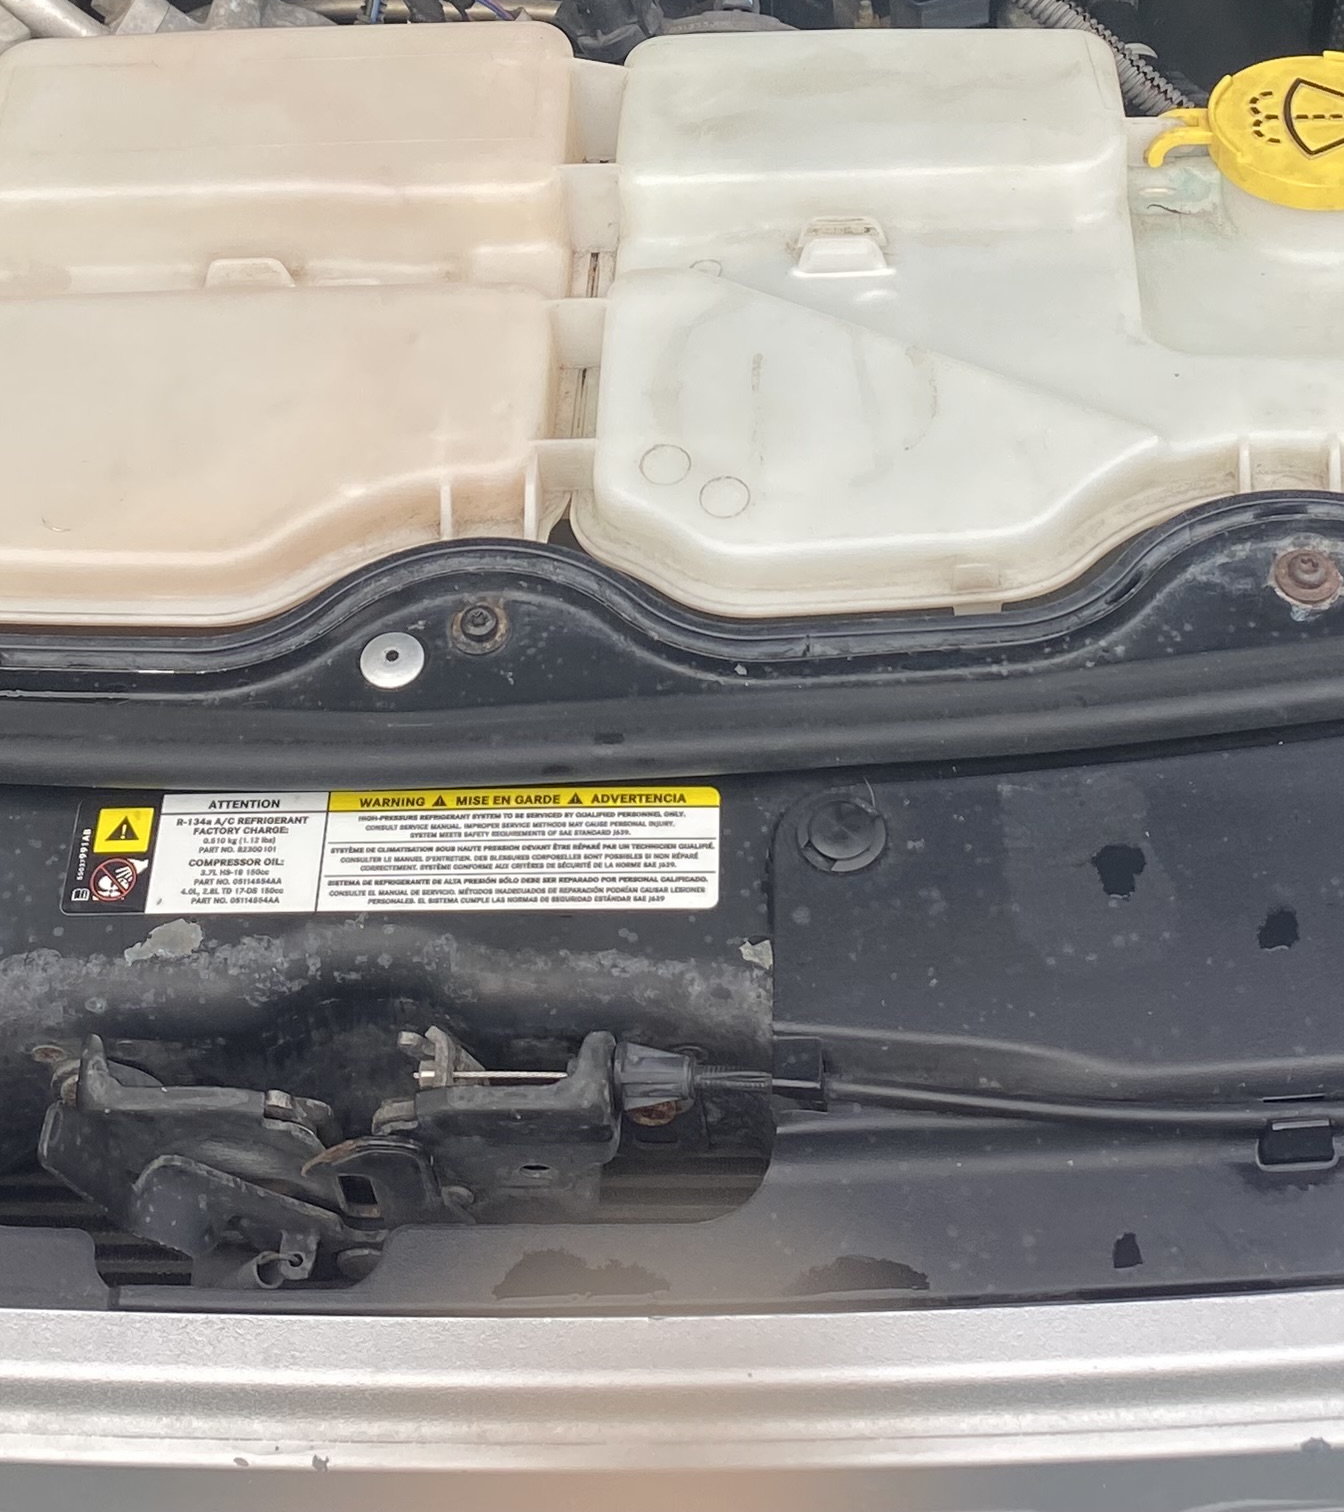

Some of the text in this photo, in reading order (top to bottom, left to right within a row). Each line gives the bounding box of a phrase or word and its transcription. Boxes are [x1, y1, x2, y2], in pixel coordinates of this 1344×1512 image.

[208, 799, 281, 809] ATTENTION
[359, 793, 687, 807] WARNING MISE EN GARDE ADVERTENCIA
[176, 816, 309, 826] R-134a A/C REFRIGERANT
[193, 826, 288, 835] FACTORY CHARGE:
[189, 858, 284, 867] COMPRESSOR OIL:
